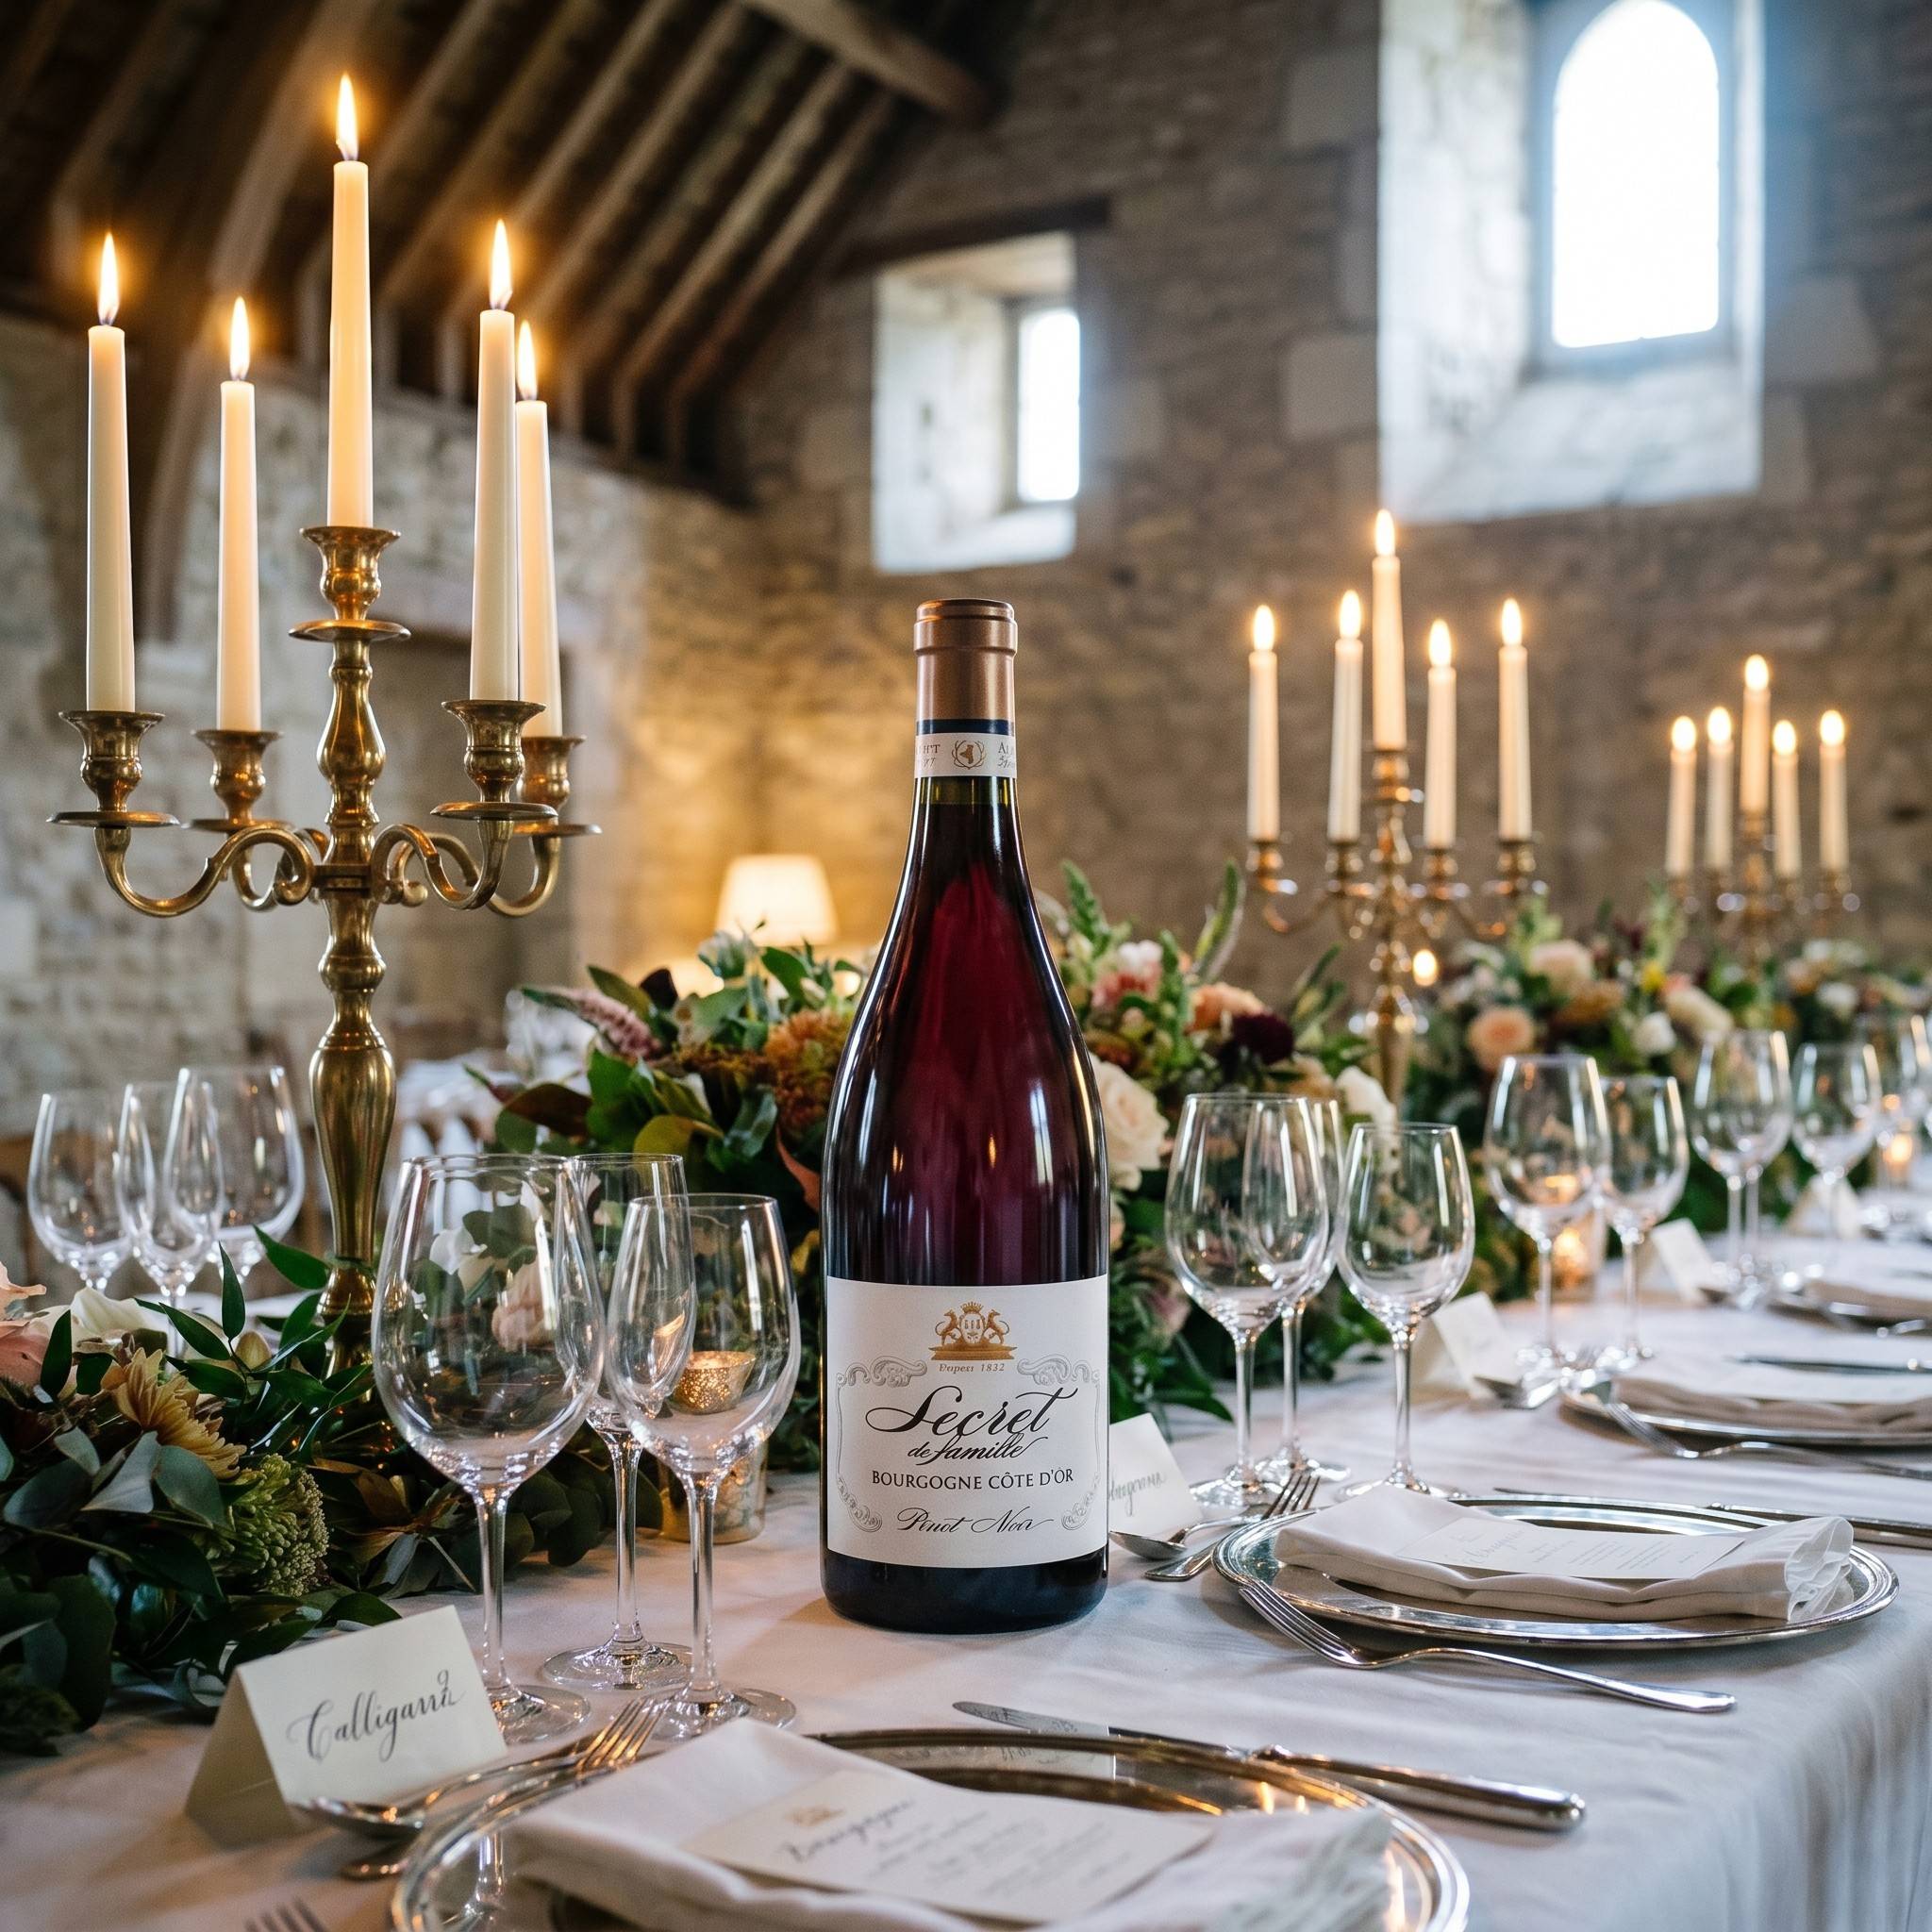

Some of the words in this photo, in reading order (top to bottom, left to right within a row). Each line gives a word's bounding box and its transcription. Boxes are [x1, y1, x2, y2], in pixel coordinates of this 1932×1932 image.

[981, 1362, 1005, 1373] 1832
[865, 1385, 1079, 1436] Secret
[907, 1441, 933, 1458] de
[915, 1432, 1049, 1466] famille
[871, 1470, 983, 1491] BOURGOGNE
[988, 1472, 1035, 1490] CÔTE
